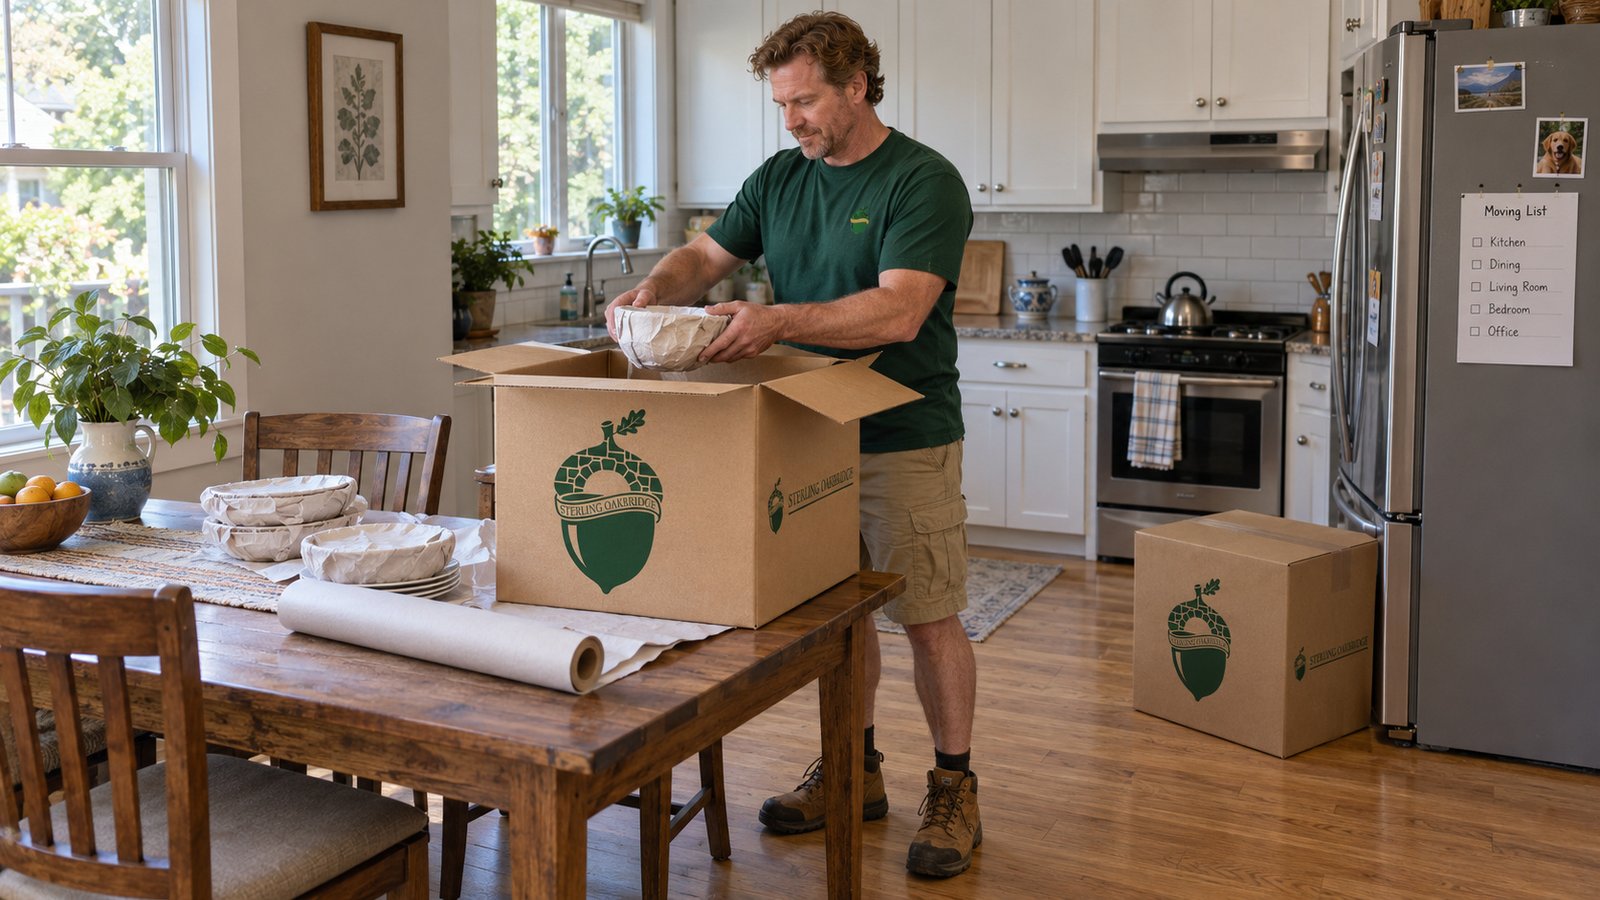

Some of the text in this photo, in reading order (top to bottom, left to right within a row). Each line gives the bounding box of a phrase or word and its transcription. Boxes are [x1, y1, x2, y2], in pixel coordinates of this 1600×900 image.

[1484, 205, 1547, 221] Moving List
[1490, 237, 1526, 247] Kitchen
[1490, 259, 1521, 273] Dining
[1489, 281, 1548, 296] Living Room
[1489, 303, 1530, 315] Bedroom
[1488, 326, 1519, 337] Office
[788, 482, 820, 508] STERLING
[560, 496, 656, 517] STERLING OAKBRIDGE
